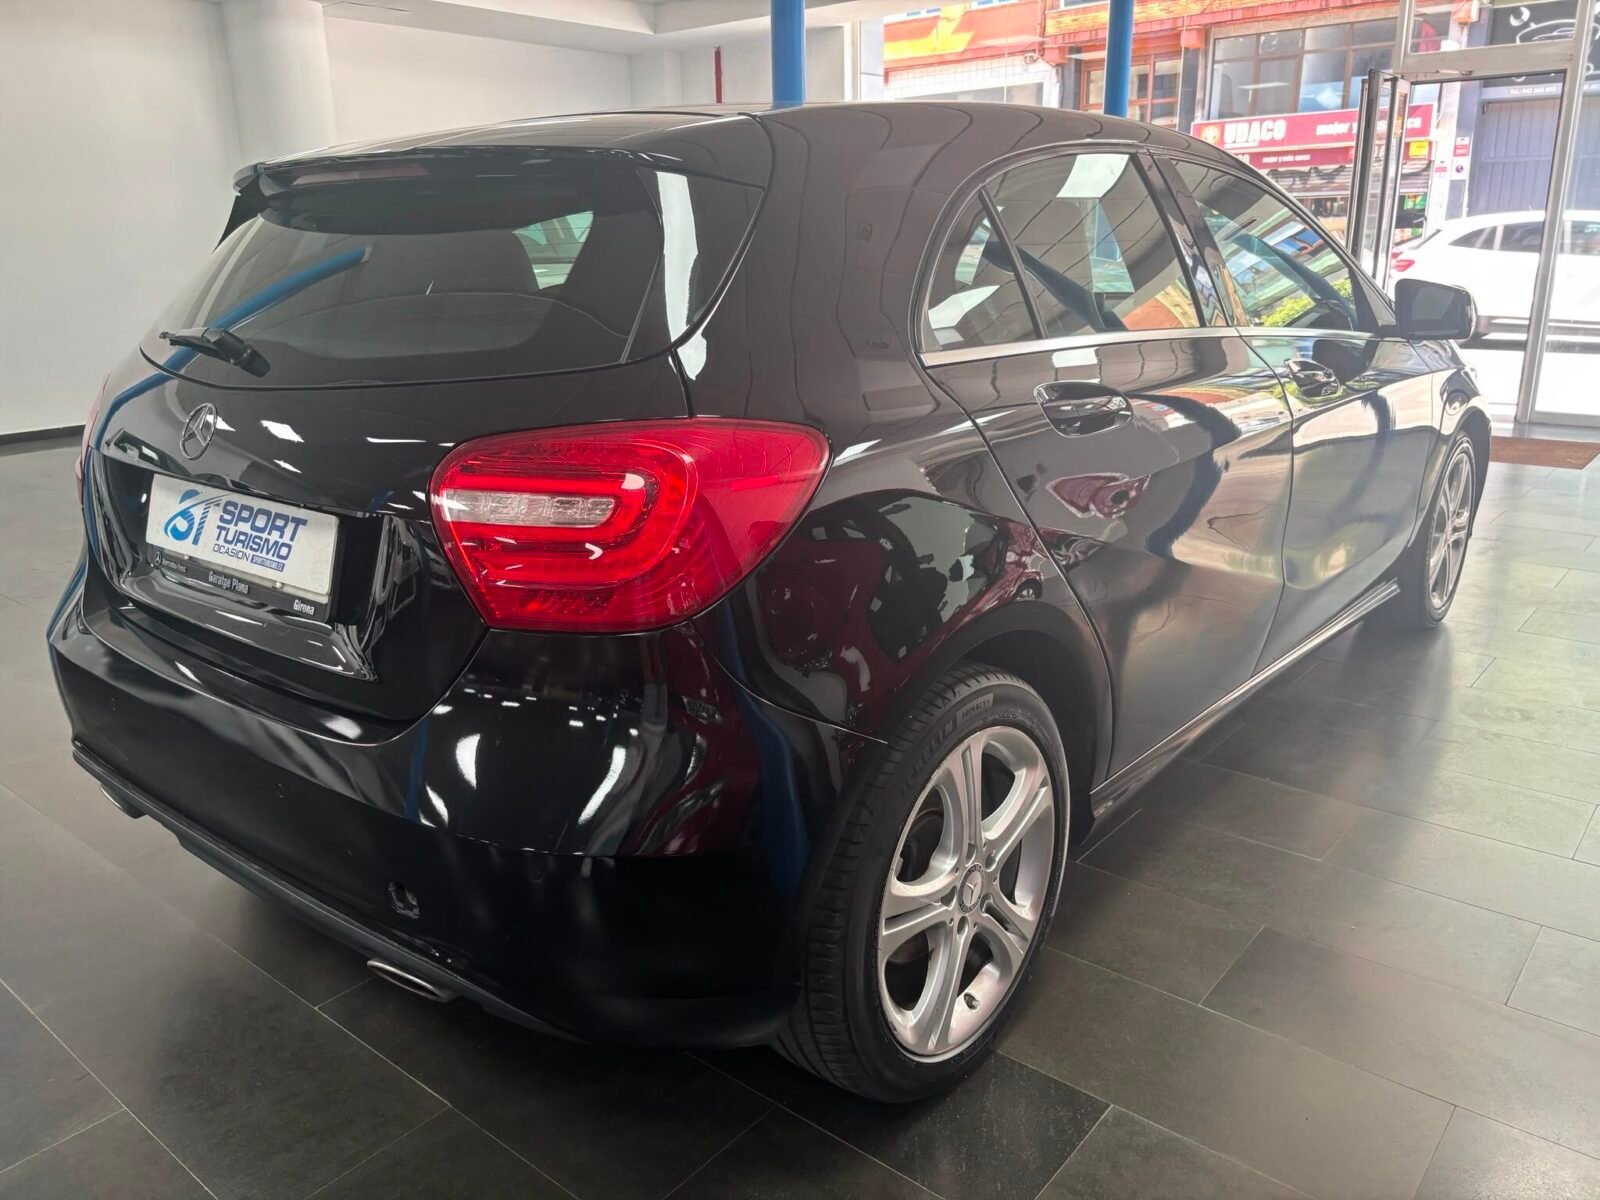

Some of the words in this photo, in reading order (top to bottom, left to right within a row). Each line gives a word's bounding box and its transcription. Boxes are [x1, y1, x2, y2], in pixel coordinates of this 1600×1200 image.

[1224, 119, 1287, 144] UDACO
[219, 500, 308, 542] SPORT
[212, 543, 249, 562] OCASION
[216, 525, 293, 561] TURISMO
[208, 570, 231, 590] Garatge
[232, 576, 249, 594] Plana
[293, 599, 315, 616] Girona
